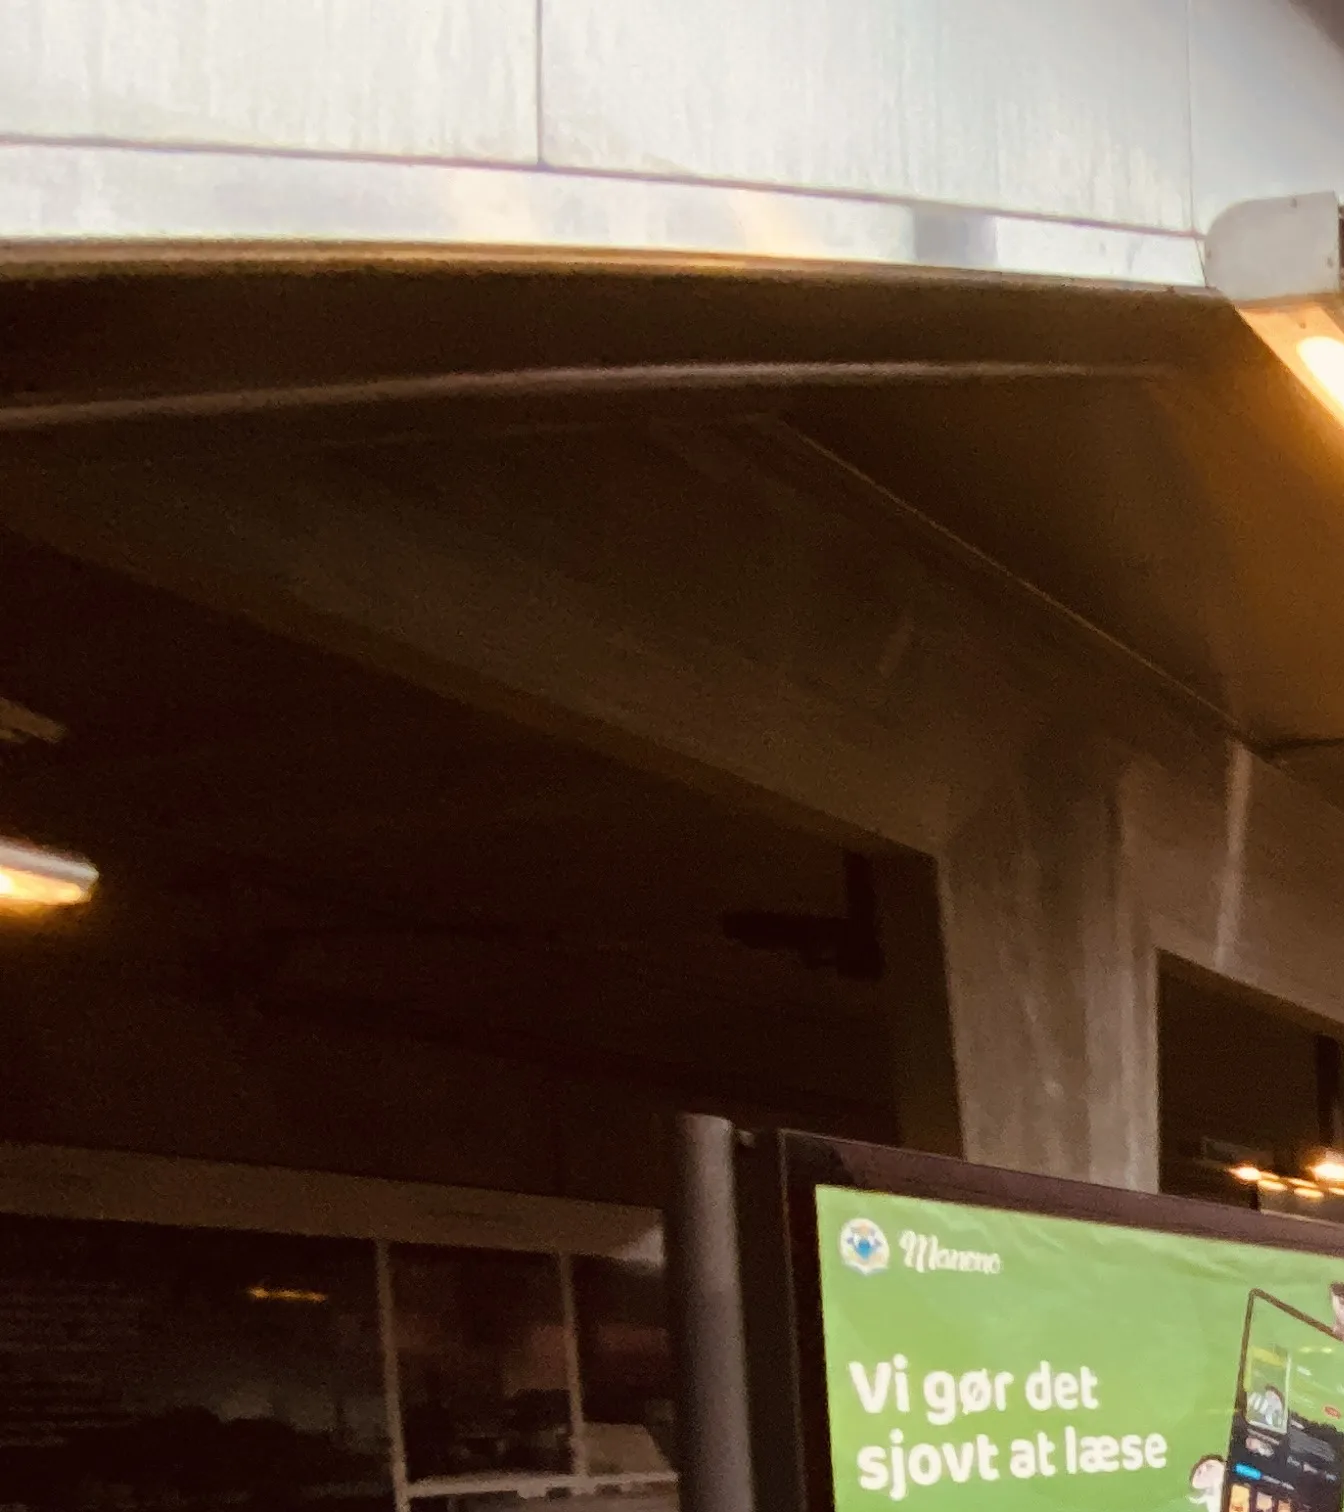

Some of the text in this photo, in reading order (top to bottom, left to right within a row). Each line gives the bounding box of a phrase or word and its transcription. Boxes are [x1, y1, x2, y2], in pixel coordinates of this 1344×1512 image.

[848, 1353, 1099, 1426] Vi gør det
[857, 1425, 1168, 1502] sjovt at læse
